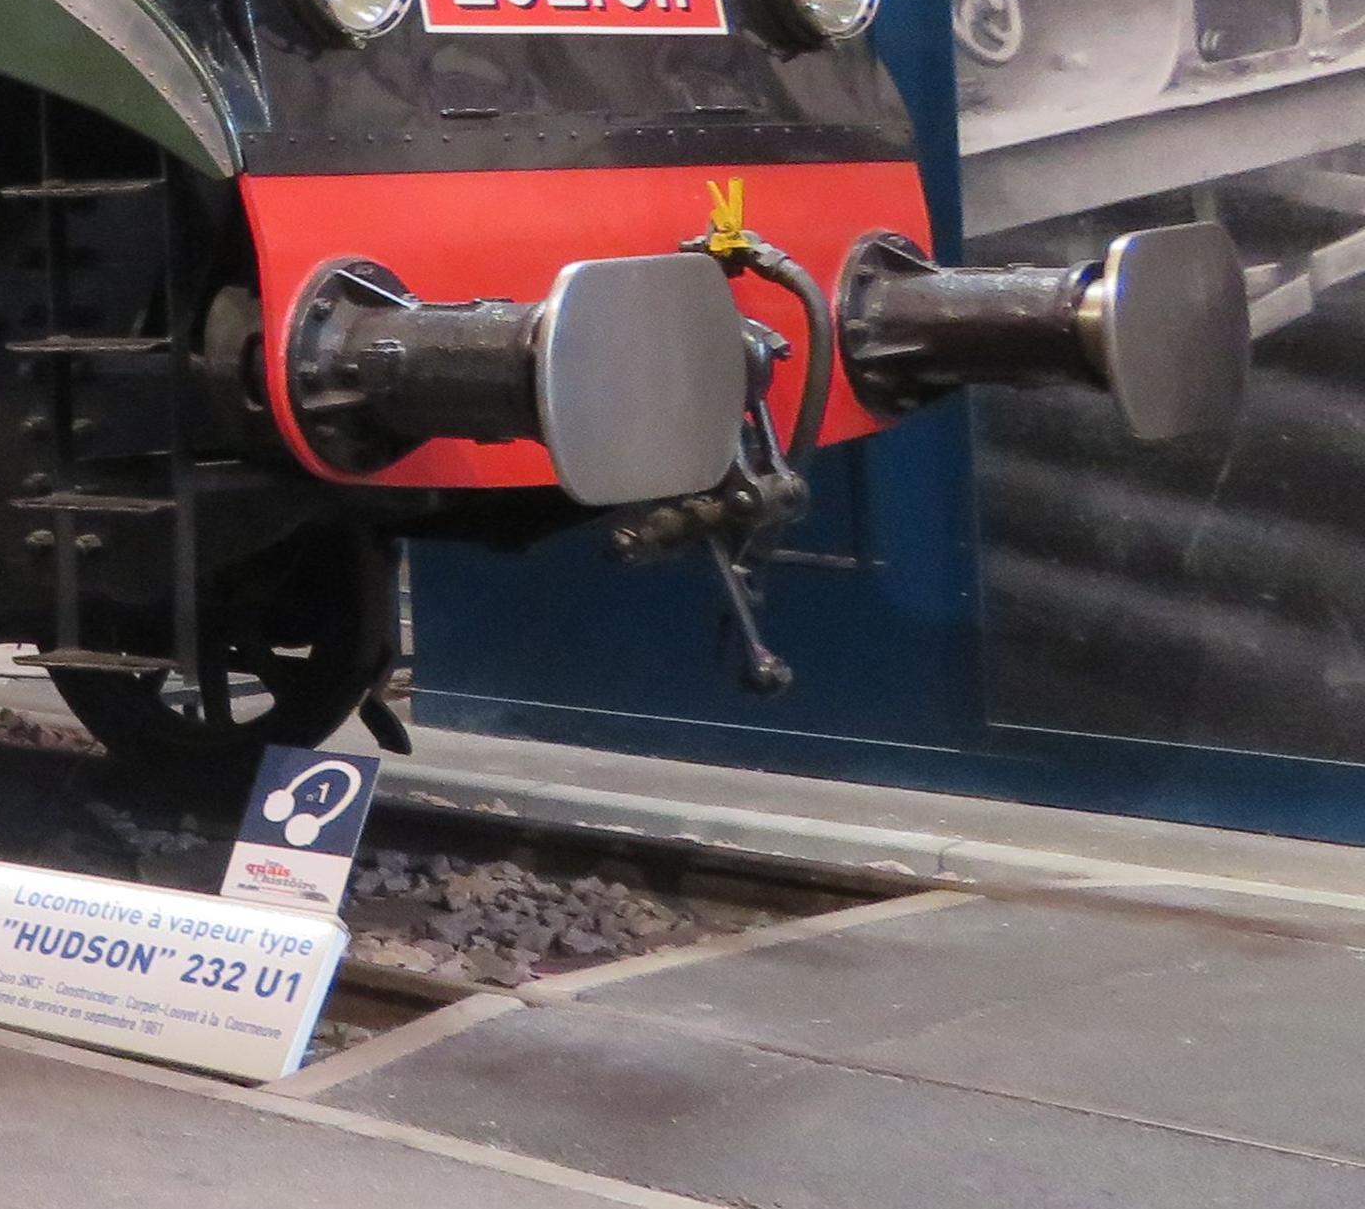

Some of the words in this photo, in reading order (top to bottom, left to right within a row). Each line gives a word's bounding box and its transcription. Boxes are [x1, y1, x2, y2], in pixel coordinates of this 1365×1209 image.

[13, 886, 143, 925] Locomotive
[147, 907, 162, 929] à
[169, 914, 253, 944] vapeur
[259, 928, 313, 957] type
[180, 953, 247, 992] 232
[254, 966, 302, 1003] U1
